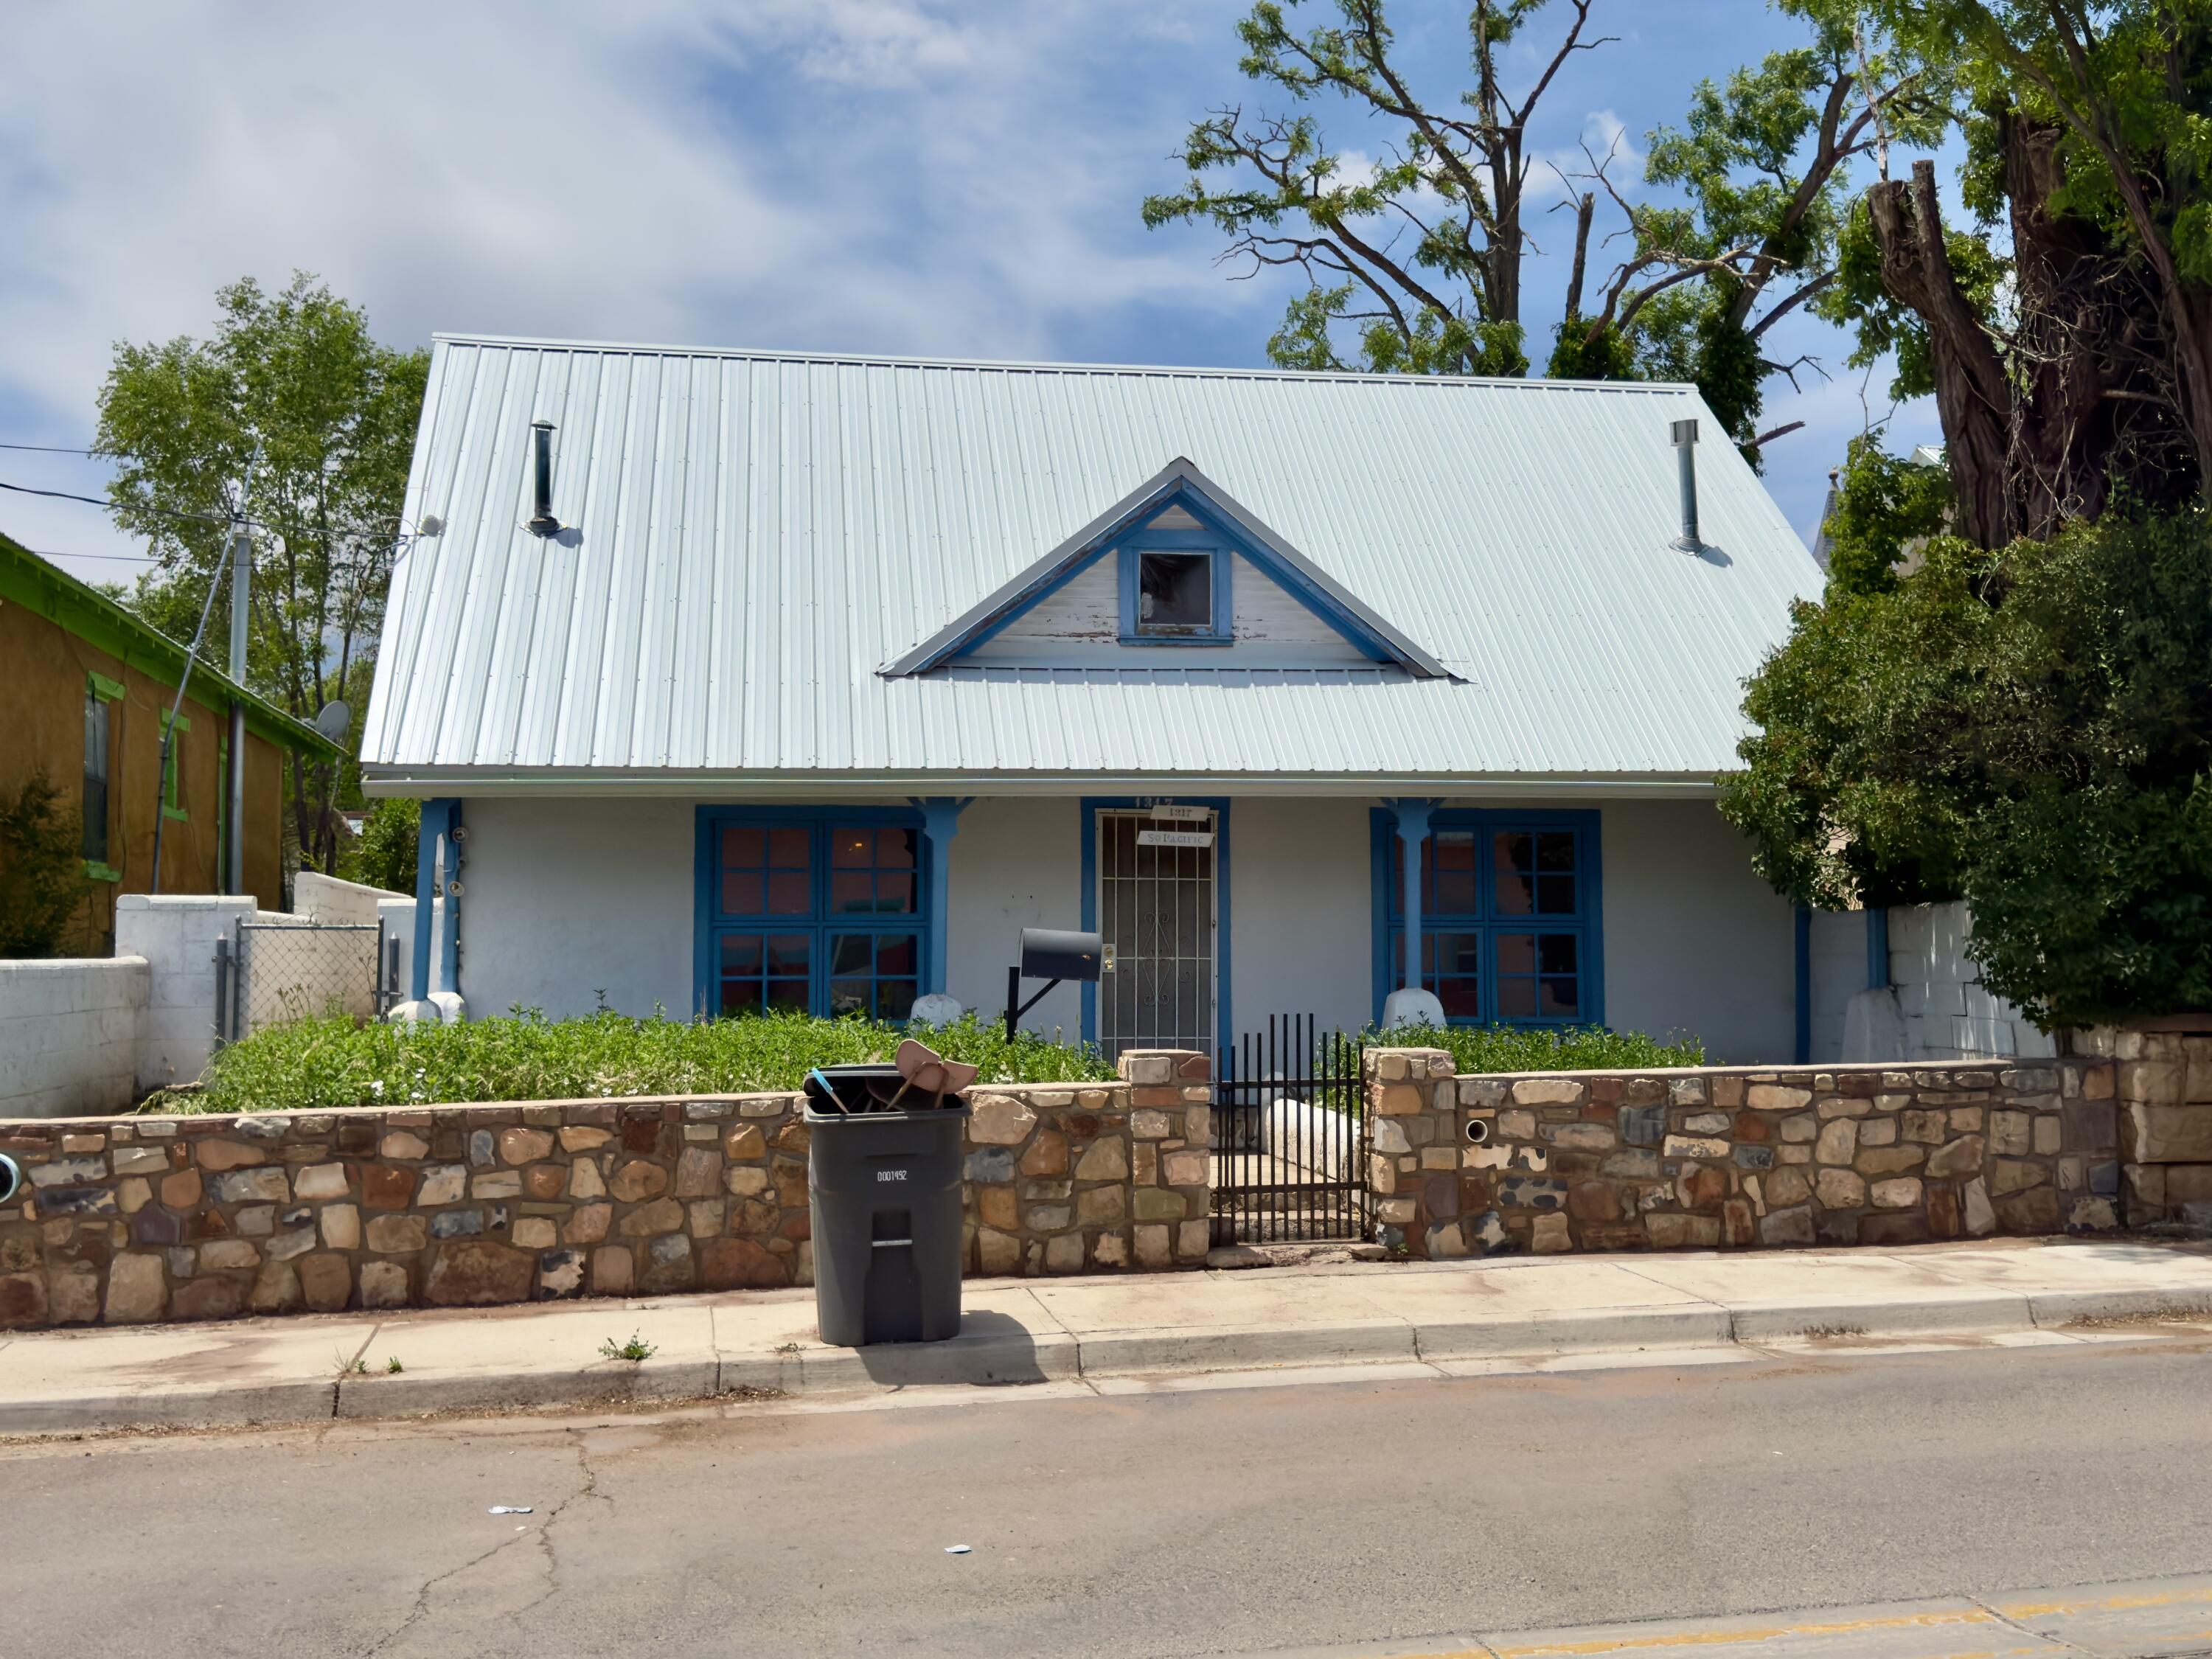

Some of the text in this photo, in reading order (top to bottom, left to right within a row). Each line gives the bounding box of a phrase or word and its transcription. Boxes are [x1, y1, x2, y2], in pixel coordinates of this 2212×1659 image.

[1134, 796, 1173, 808] 1317
[1169, 807, 1192, 817] 1317
[877, 1170, 908, 1181] 0001492
